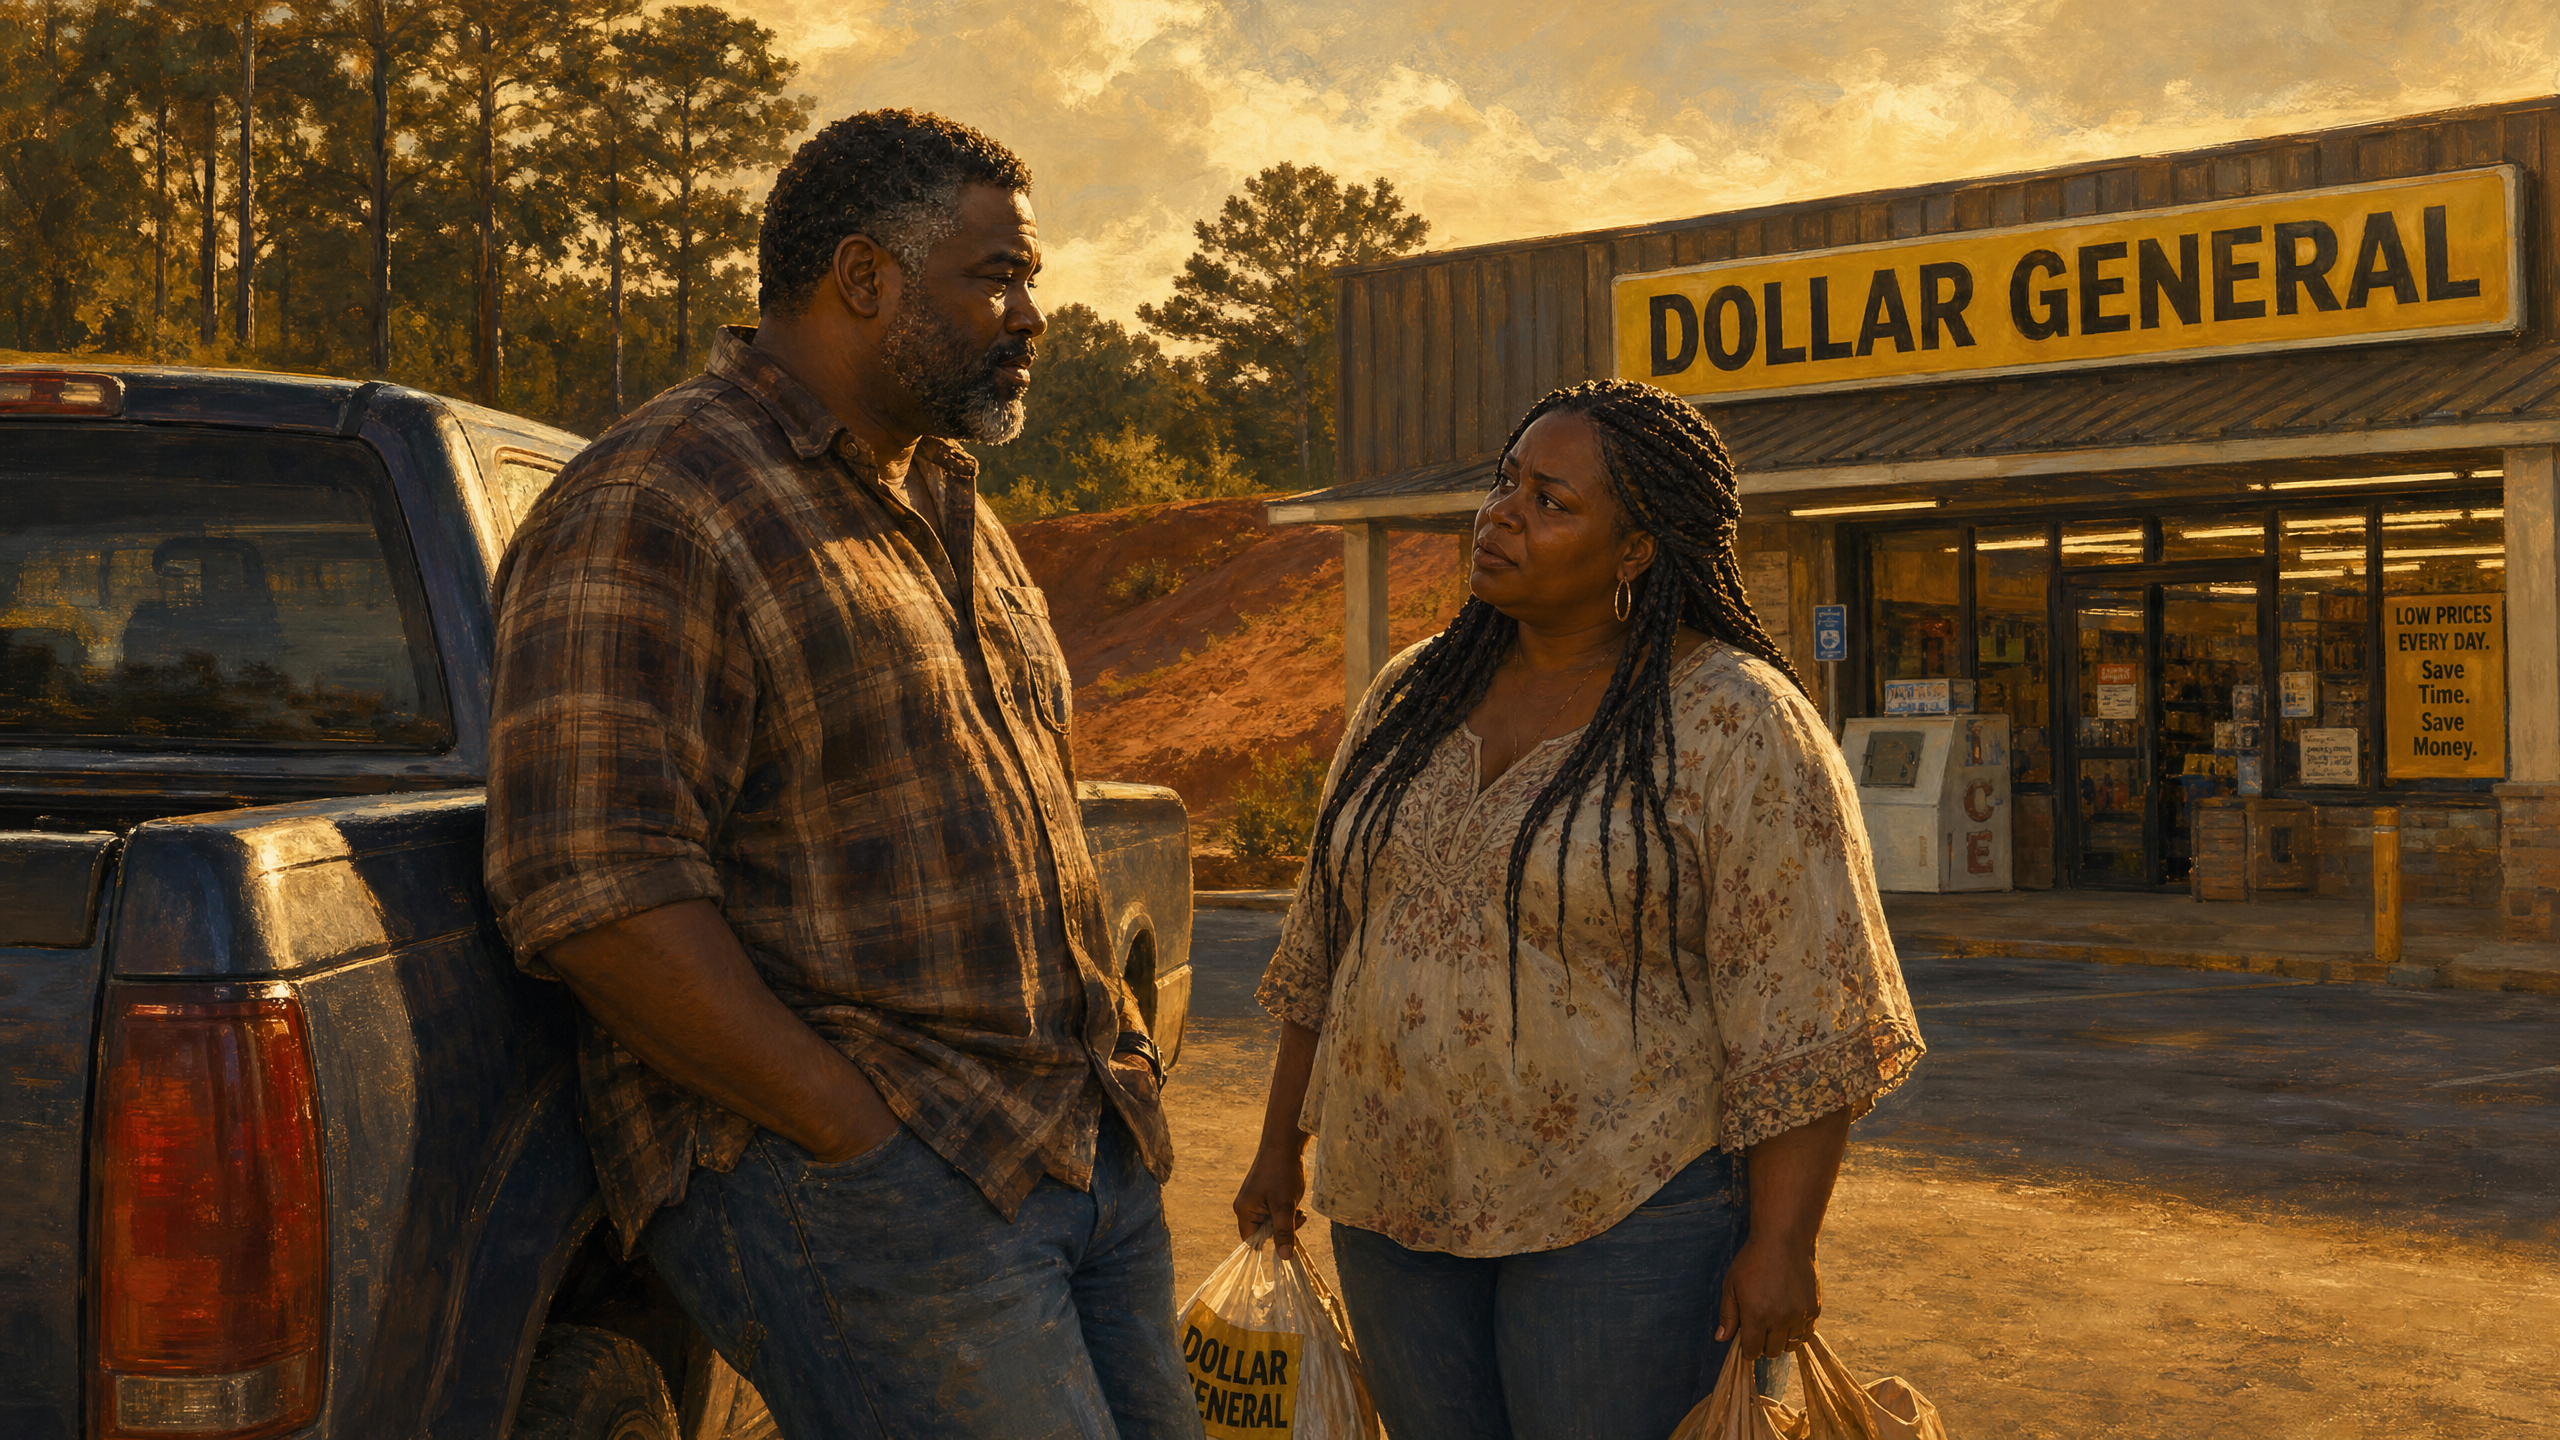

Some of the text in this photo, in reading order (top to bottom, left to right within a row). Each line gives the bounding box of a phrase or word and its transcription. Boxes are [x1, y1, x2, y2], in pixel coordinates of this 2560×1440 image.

[1648, 204, 2481, 377] DOLLAR GENERAL
[2395, 604, 2493, 626] LOW PRICES
[2398, 631, 2490, 652] EVERY DAY.
[2421, 659, 2465, 680] Save
[2418, 683, 2470, 704] Time.
[2421, 711, 2465, 732] Save
[2413, 736, 2478, 762] Money.
[1963, 725, 1995, 875] ICE
[1182, 1324, 1288, 1386] DOLLAR
[1188, 1372, 1288, 1429] ENERAL
